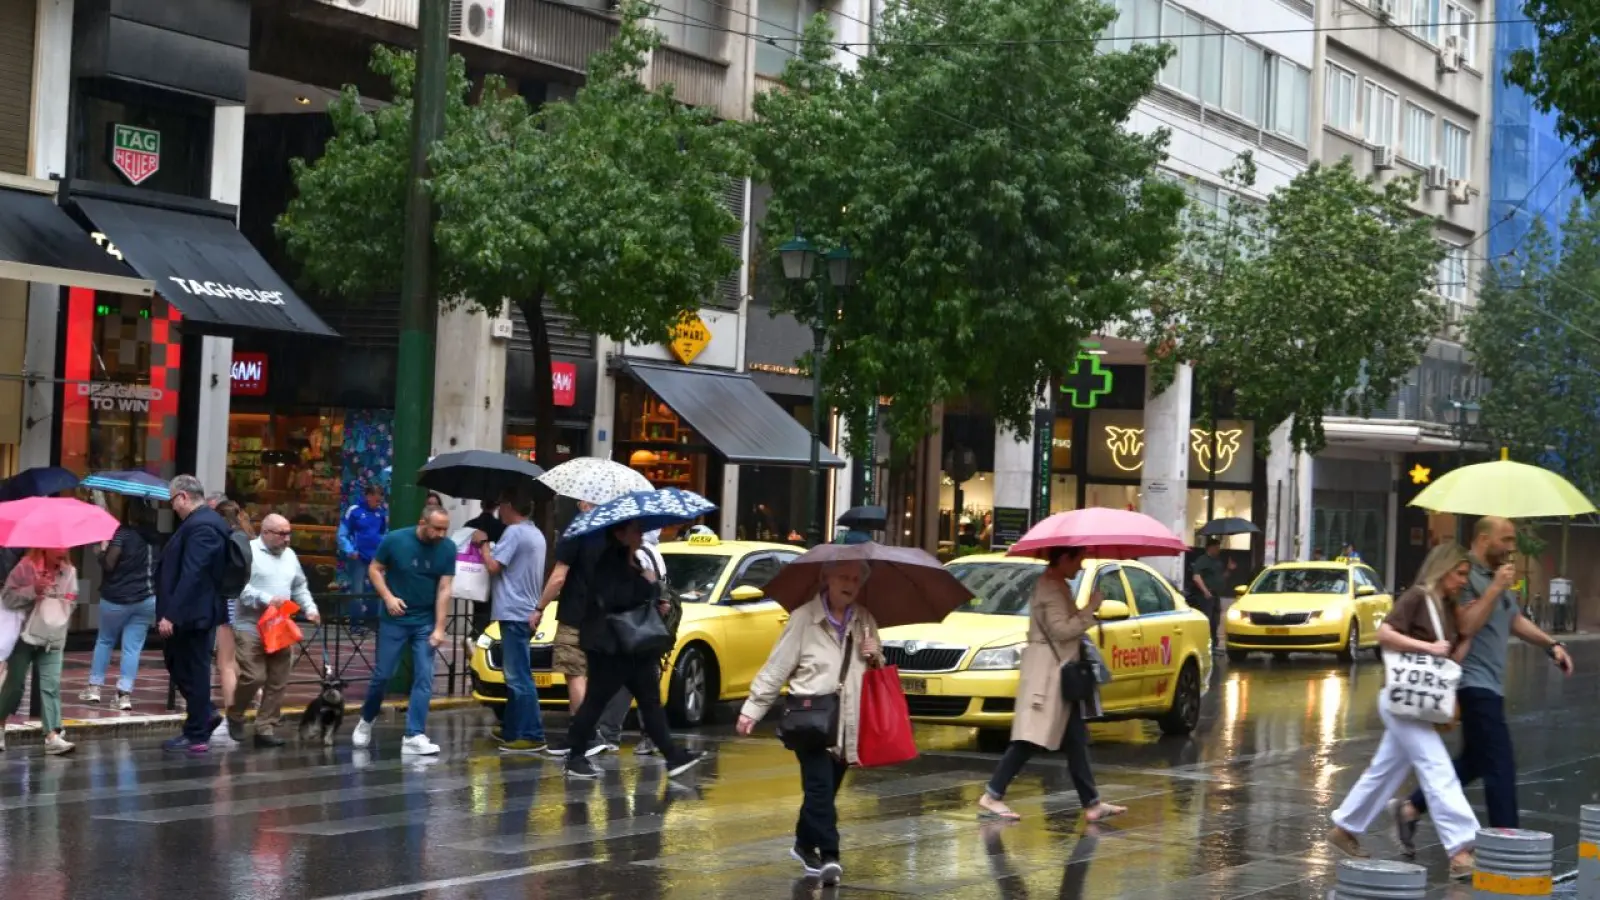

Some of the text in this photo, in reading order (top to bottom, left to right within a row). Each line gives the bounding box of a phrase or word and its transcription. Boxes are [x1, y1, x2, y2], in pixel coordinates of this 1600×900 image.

[118, 129, 156, 151] TAG
[115, 150, 156, 180] HEUER
[78, 383, 162, 401] DESIGNED
[92, 398, 149, 412] TO WIN
[1392, 667, 1449, 690] YORK
[1390, 687, 1445, 711] CITY
